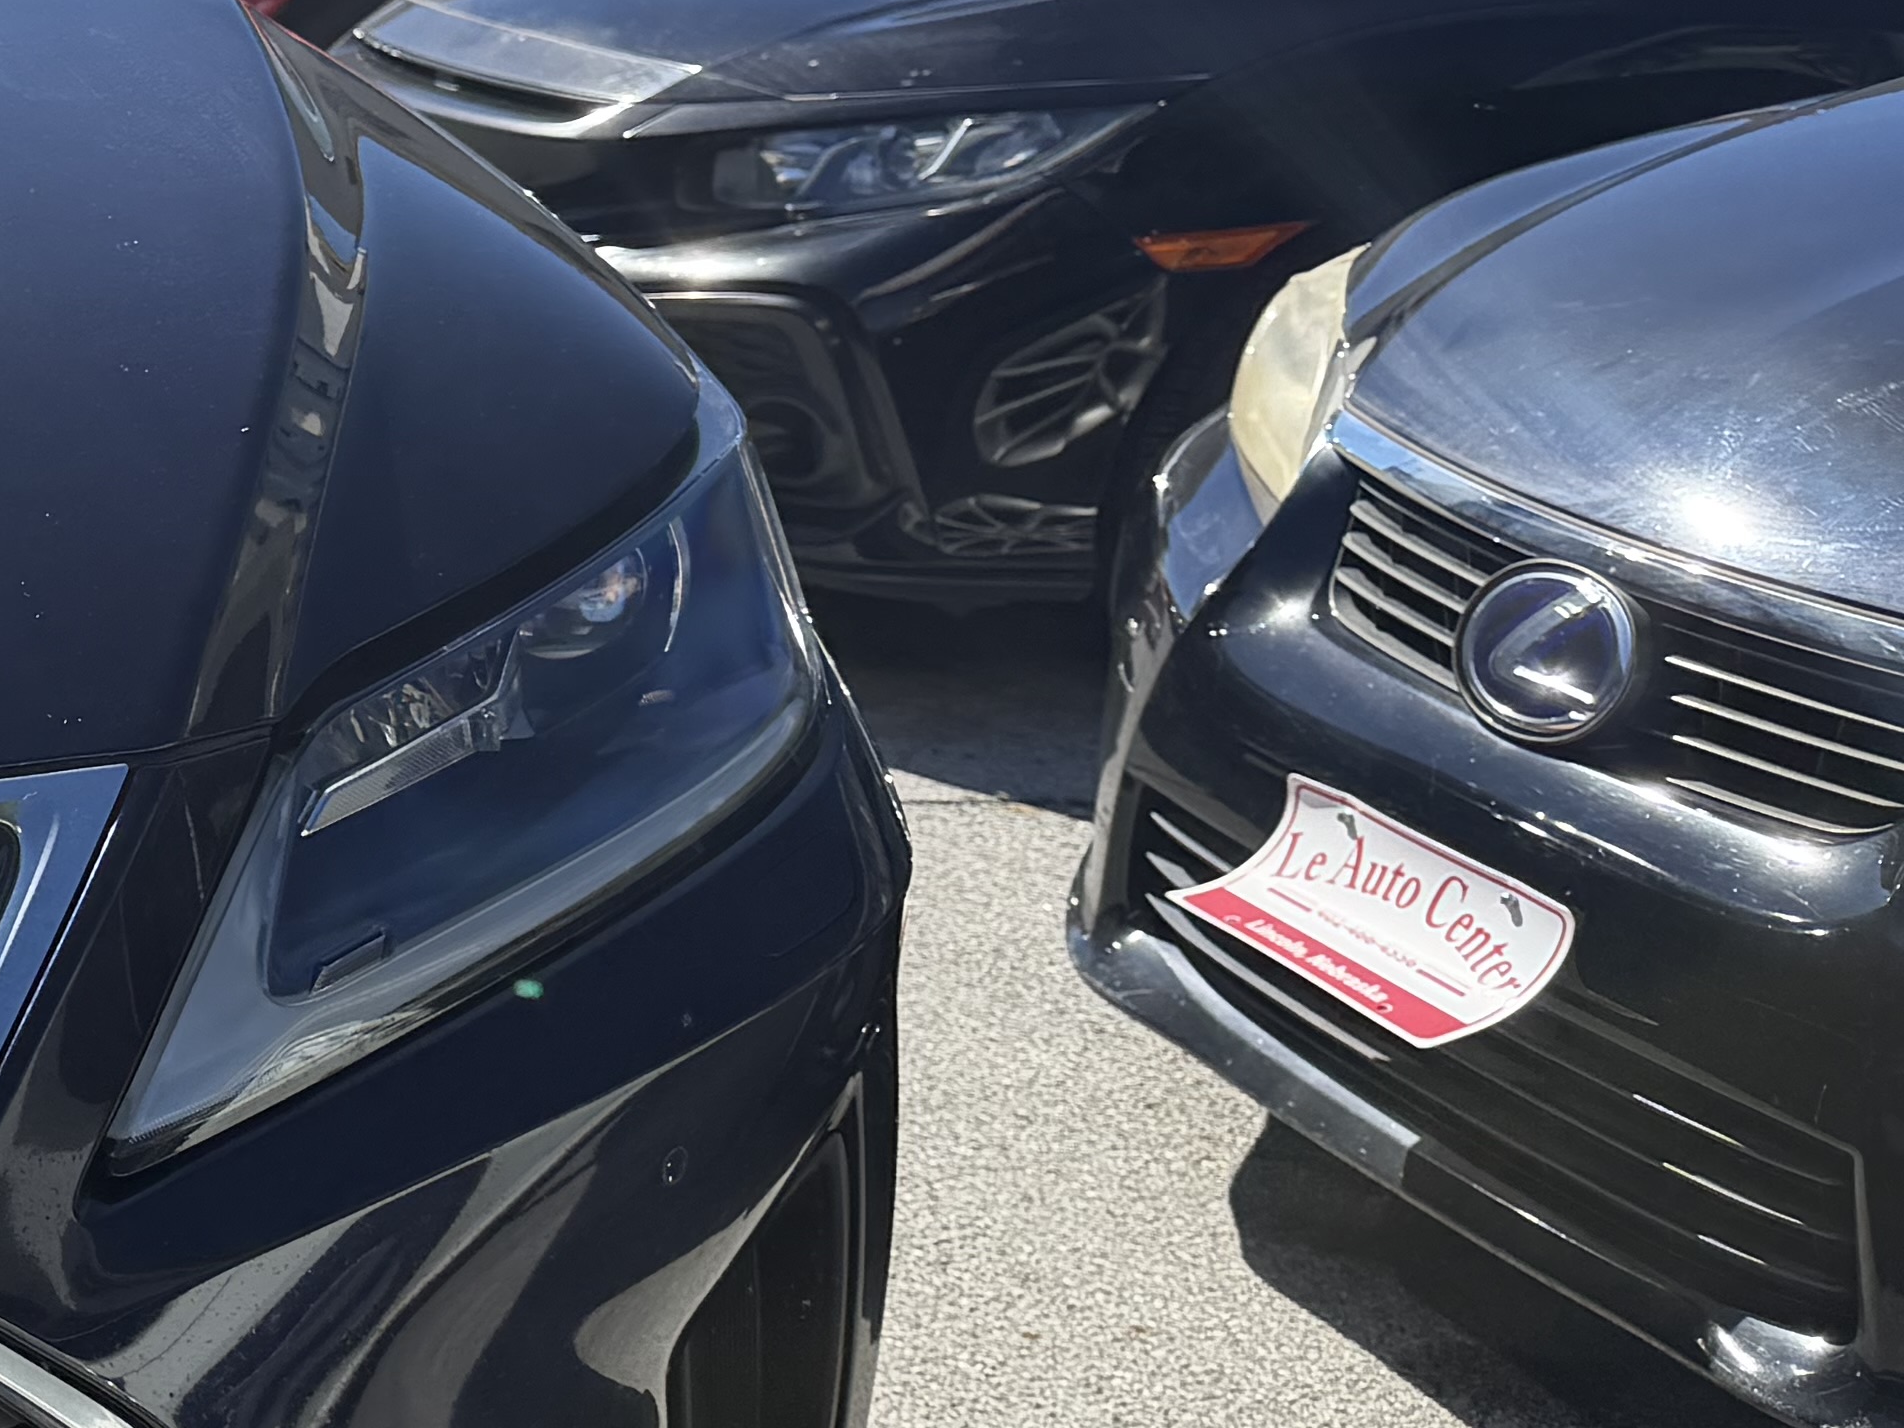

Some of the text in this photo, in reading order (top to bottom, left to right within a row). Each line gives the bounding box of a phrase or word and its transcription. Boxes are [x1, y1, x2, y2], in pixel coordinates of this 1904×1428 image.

[1271, 831, 1523, 992] Le Auto Center
